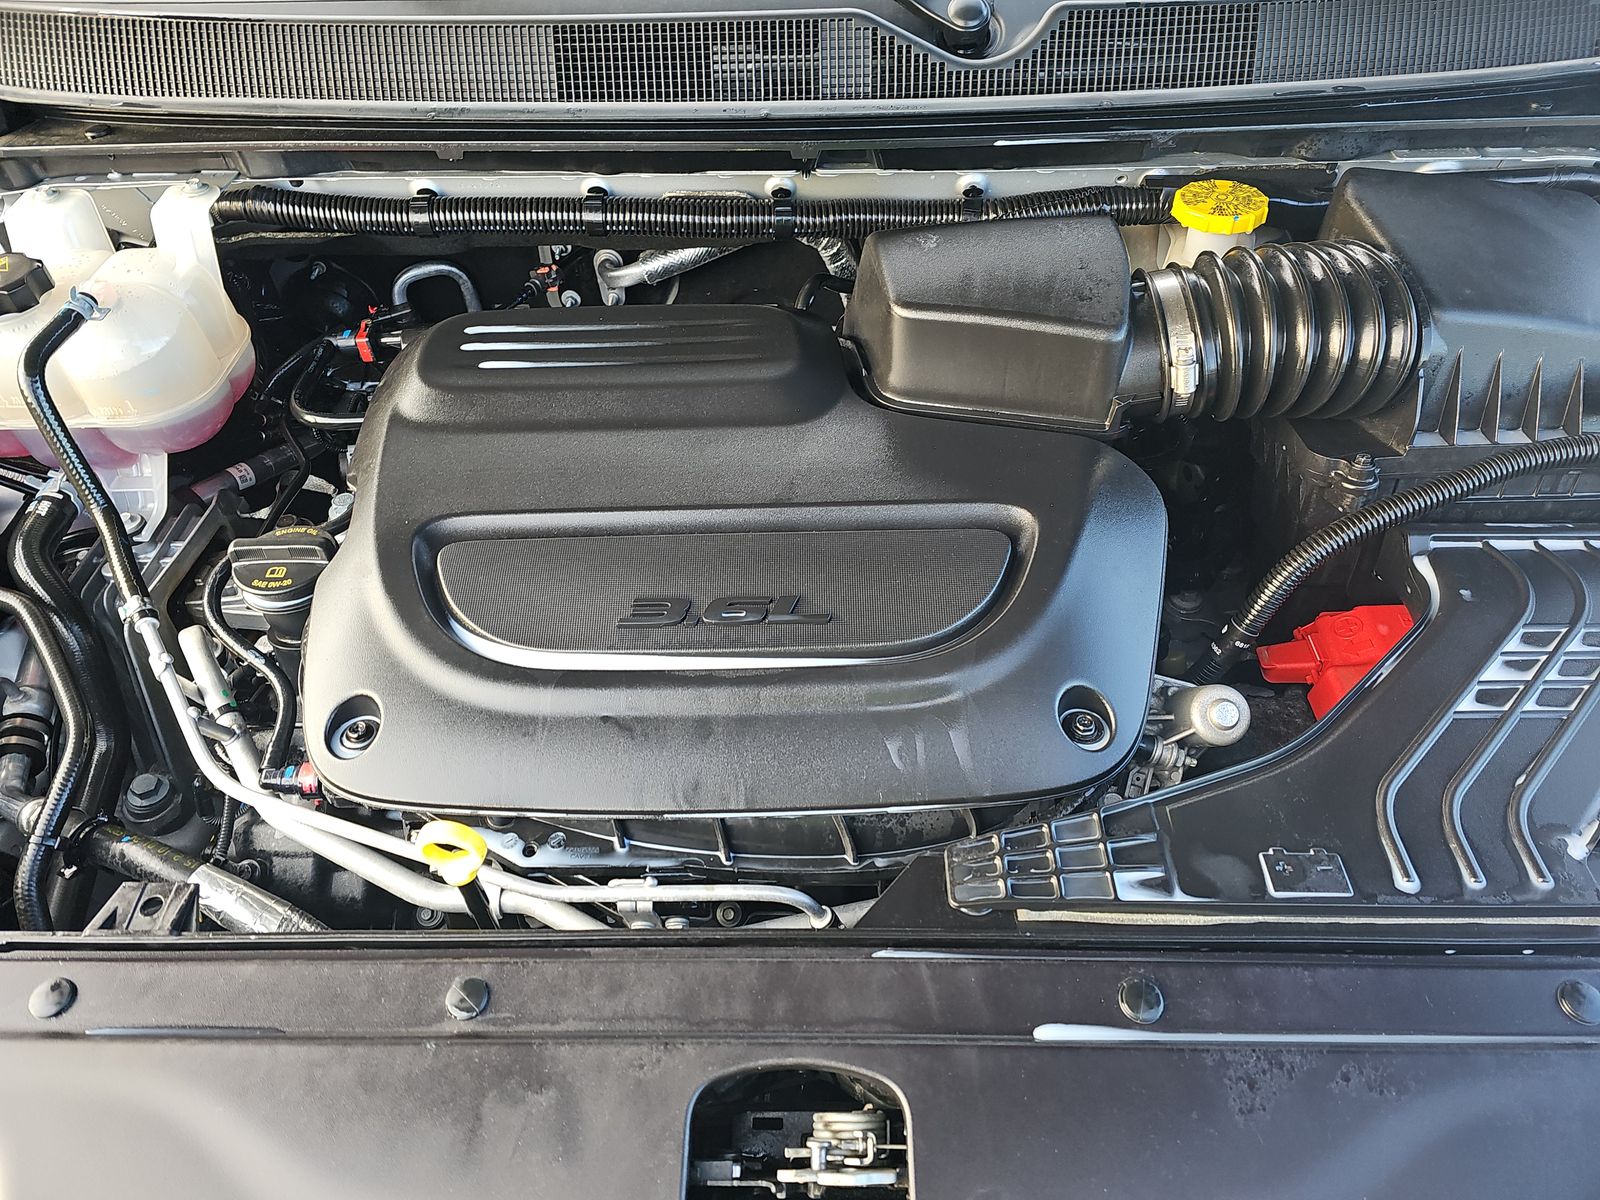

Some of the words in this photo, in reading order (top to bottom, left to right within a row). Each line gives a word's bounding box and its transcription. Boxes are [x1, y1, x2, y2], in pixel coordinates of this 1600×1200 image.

[275, 527, 306, 537] ENGINE
[306, 527, 319, 536] OIL
[251, 579, 267, 588] SAE
[267, 579, 292, 588] 0W-20
[616, 594, 832, 629] 3.6L
